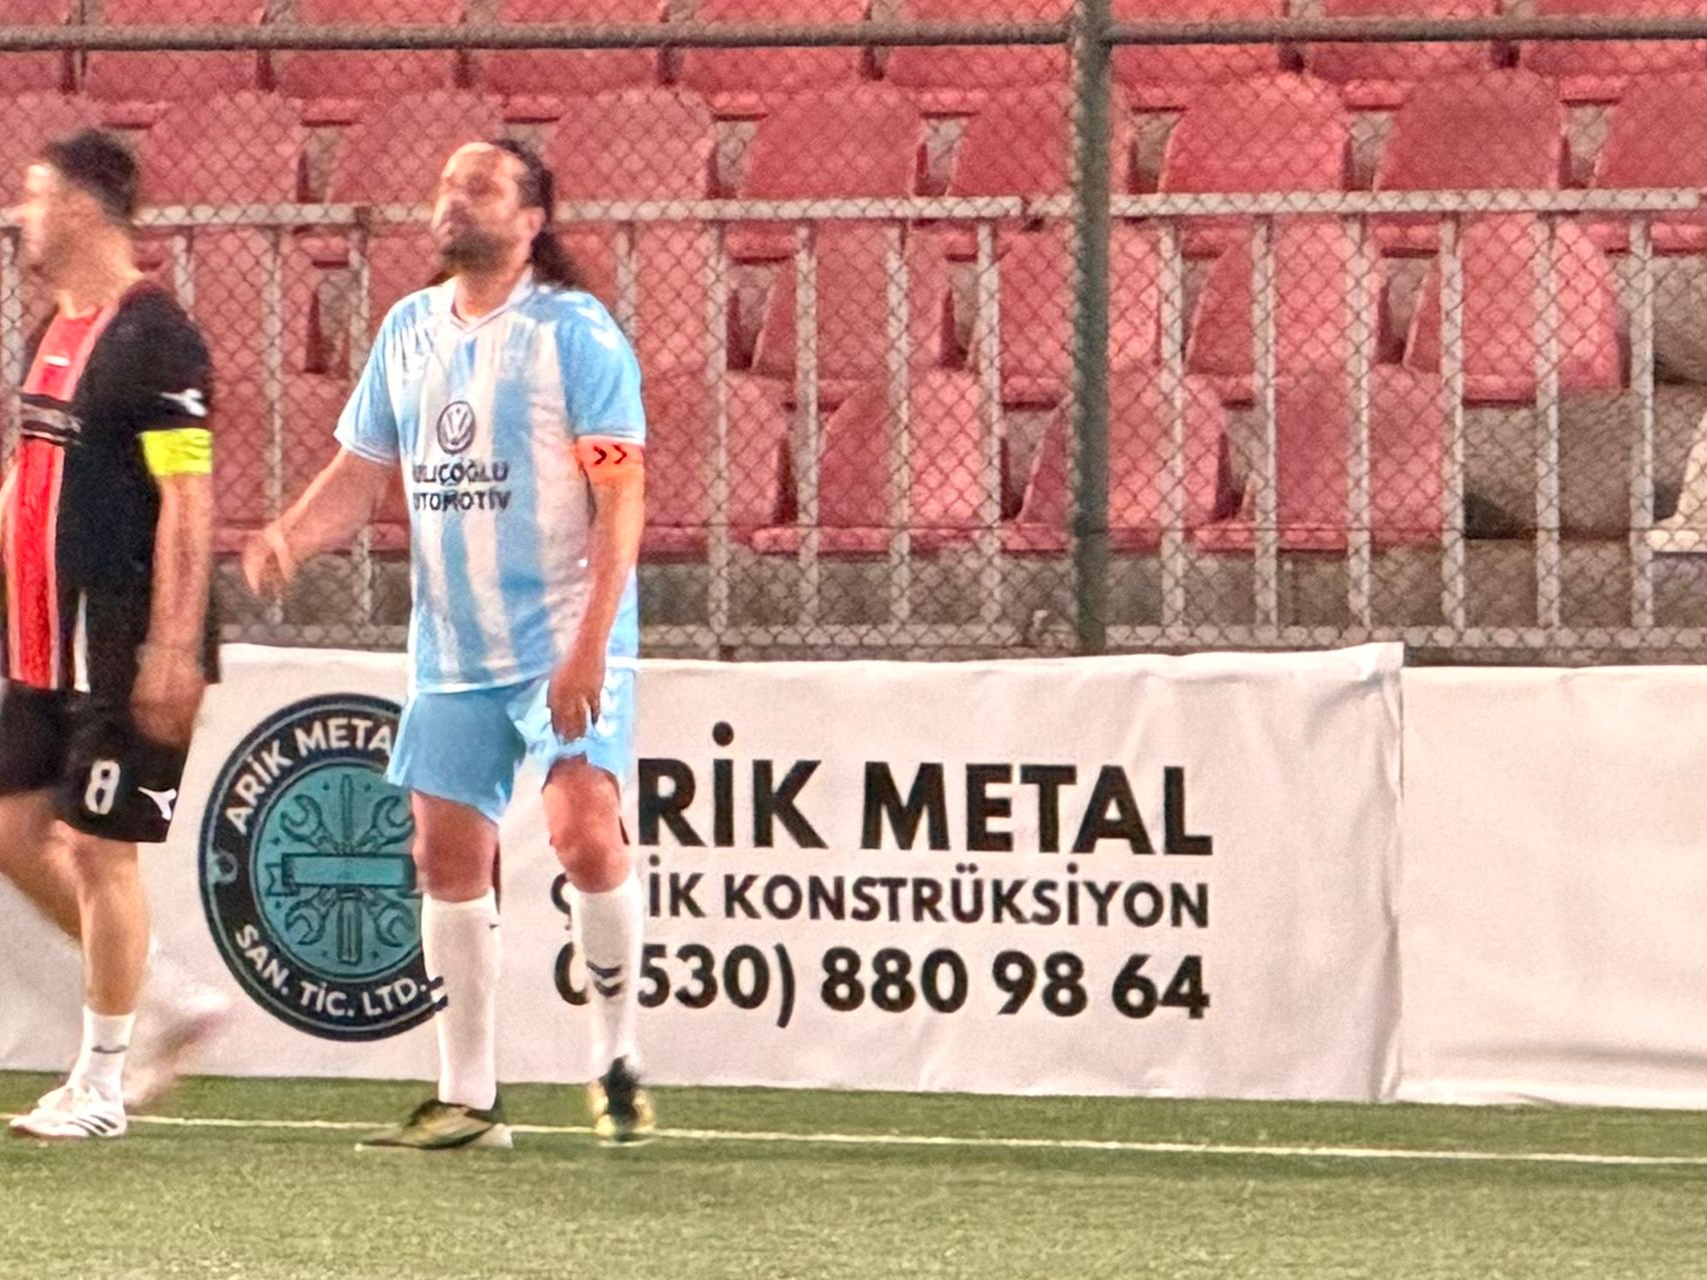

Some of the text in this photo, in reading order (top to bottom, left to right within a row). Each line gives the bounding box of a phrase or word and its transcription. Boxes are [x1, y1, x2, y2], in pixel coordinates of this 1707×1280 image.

[293, 717, 395, 758] META
[84, 757, 121, 815] 8
[623, 721, 1214, 856] RİK METAL
[550, 854, 1210, 931] ÇİK KONSTRÜKSİYON
[236, 923, 429, 1019] SAN. TİC. LTD.
[553, 942, 1212, 1028] 0530) 880 98 64
